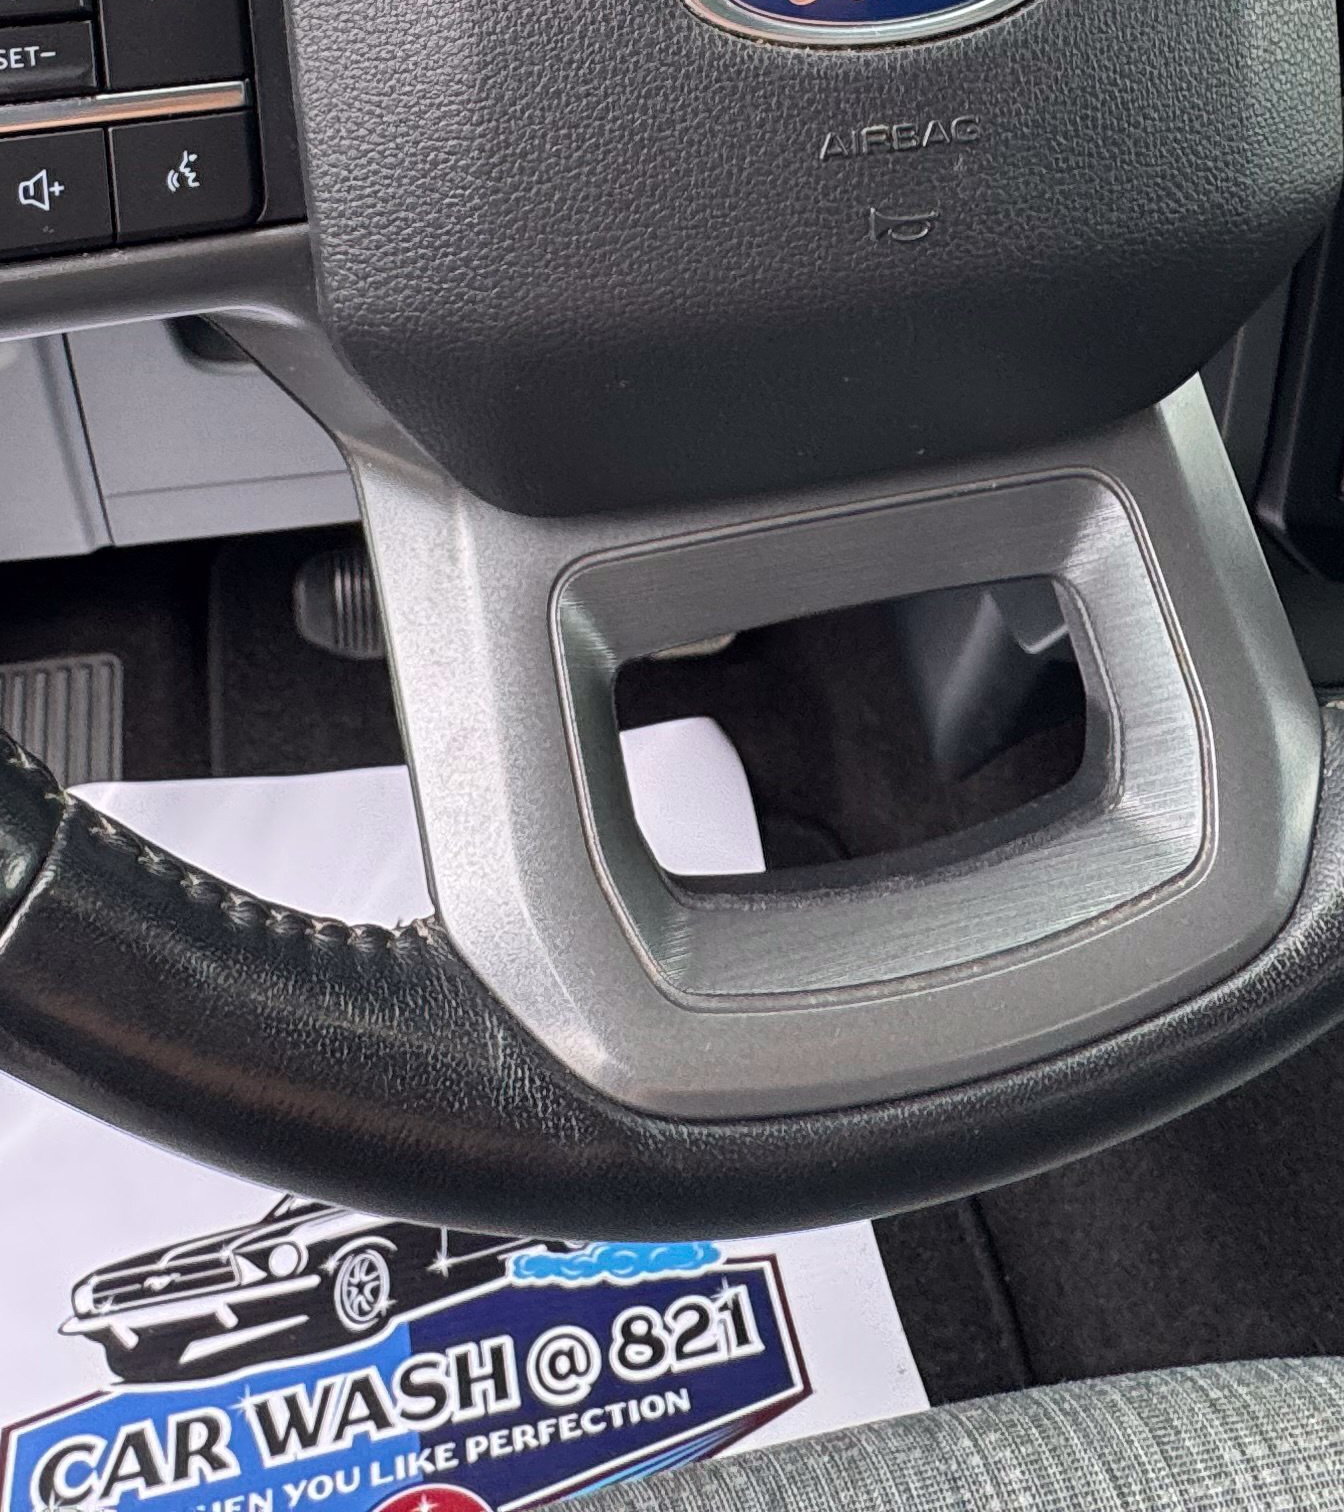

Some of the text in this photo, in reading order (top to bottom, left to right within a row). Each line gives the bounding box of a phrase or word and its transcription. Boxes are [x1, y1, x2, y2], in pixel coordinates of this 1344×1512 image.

[819, 116, 982, 160] AIRBAG
[29, 1284, 766, 1512] CAR WASH @ 821
[282, 1465, 361, 1507] YOU
[369, 1439, 460, 1487] LIKE
[466, 1386, 692, 1465] PERFECTION
